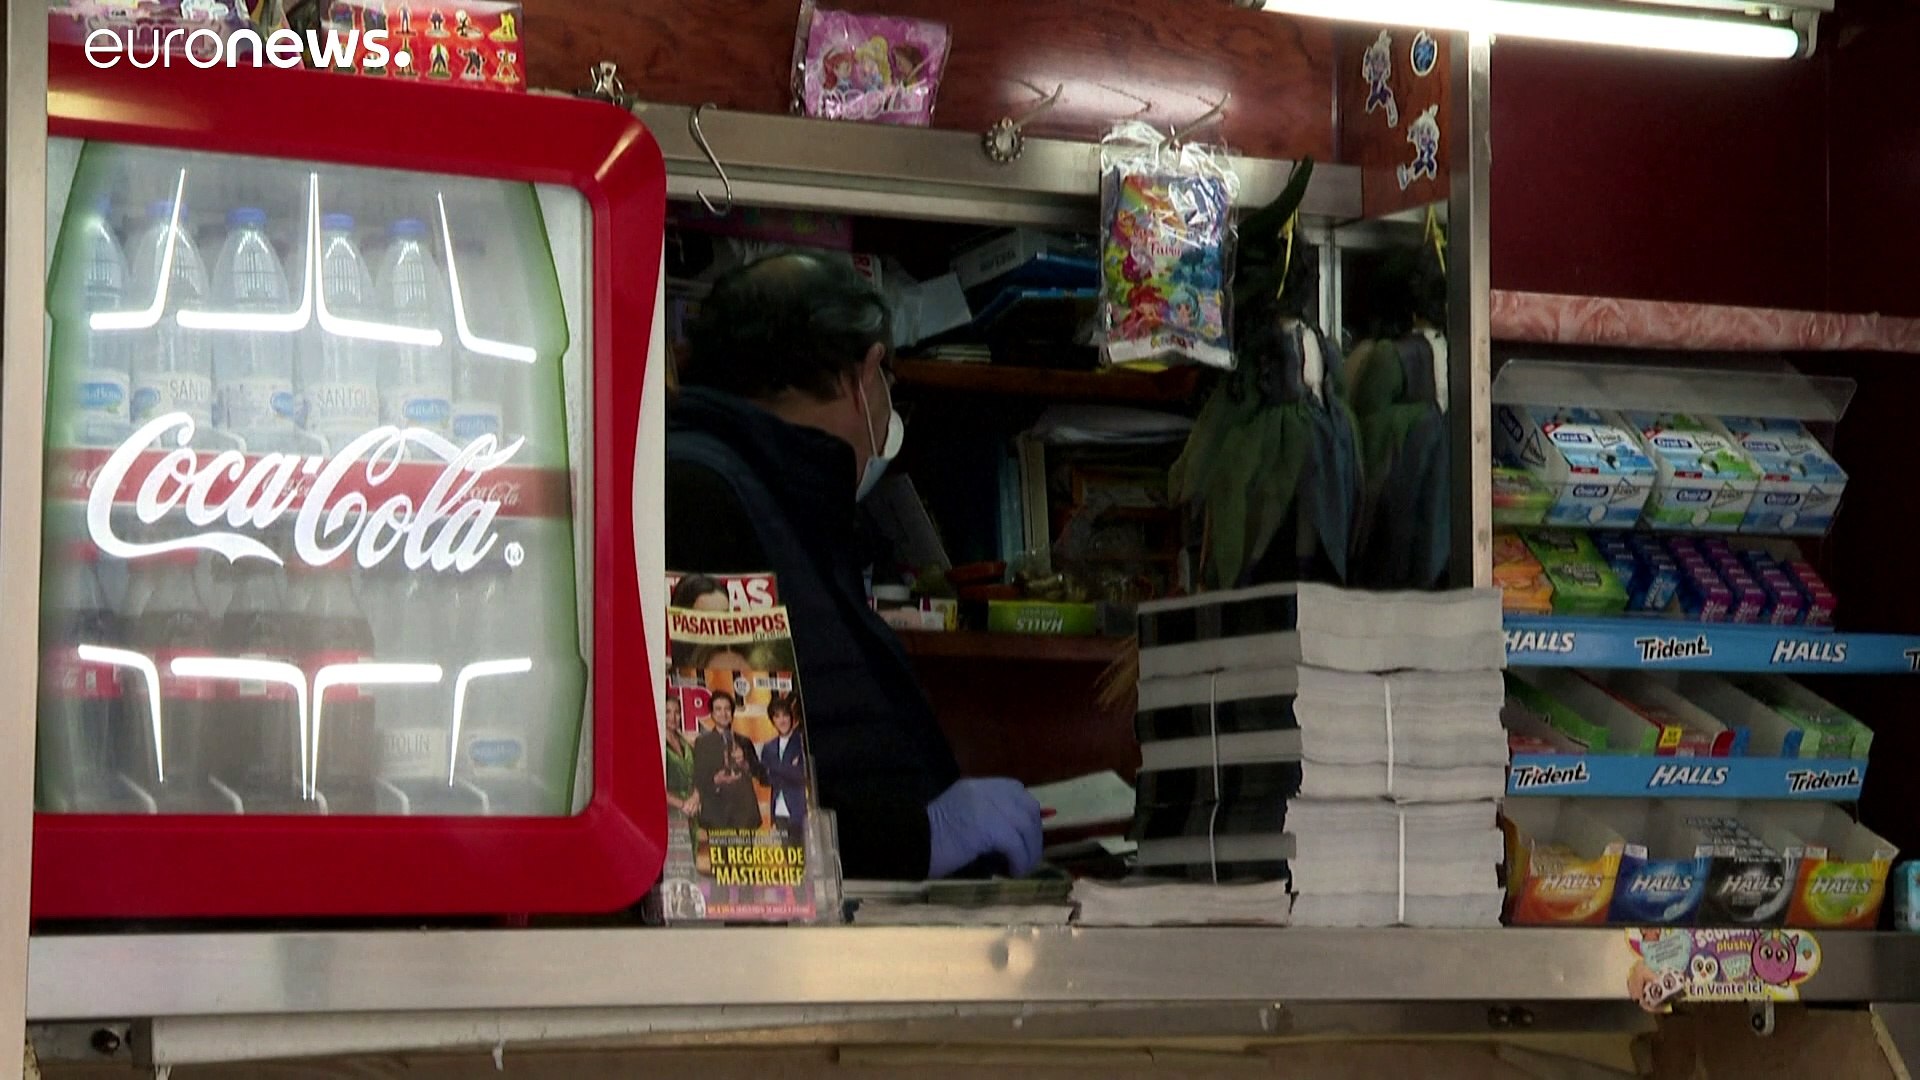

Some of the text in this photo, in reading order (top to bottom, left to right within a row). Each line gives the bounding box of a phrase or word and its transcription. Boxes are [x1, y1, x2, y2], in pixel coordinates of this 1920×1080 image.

[87, 411, 525, 573] Coca-Cola
[672, 613, 786, 636] PASATIEMPOS
[1502, 630, 1576, 653] HALLS
[1636, 636, 1710, 660] Trident
[1770, 640, 1848, 664] HALLS
[1513, 762, 1861, 792] Trident HALLS Trident
[710, 846, 805, 865] EL REGRESO DE
[1541, 872, 1602, 890] HALLS
[1630, 874, 1693, 892] HALLS
[1720, 876, 1784, 896] HALLS
[1811, 876, 1873, 894] HALLS
[1716, 939, 1753, 954] plushy
[1689, 984, 1705, 997] En
[1706, 983, 1745, 997] Vente
